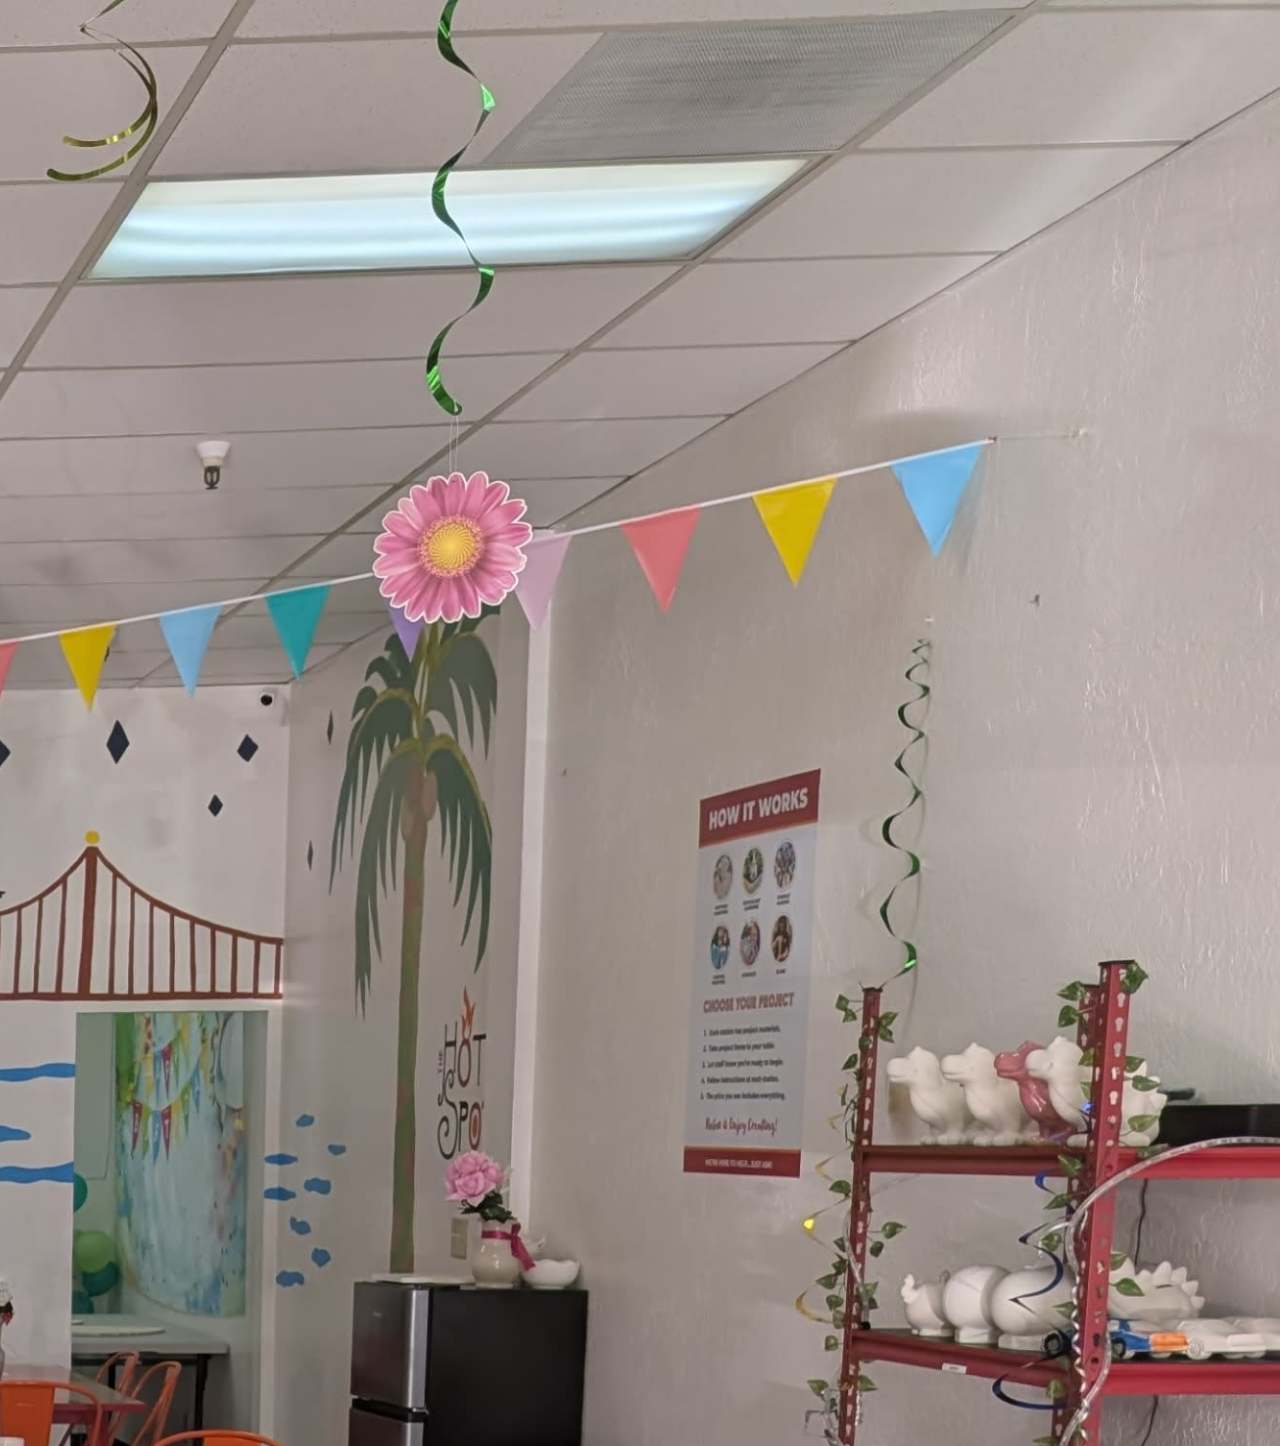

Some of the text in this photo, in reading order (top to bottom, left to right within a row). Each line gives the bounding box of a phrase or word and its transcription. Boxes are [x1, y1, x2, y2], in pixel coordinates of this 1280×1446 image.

[709, 787, 808, 830] HOW IT WORKS
